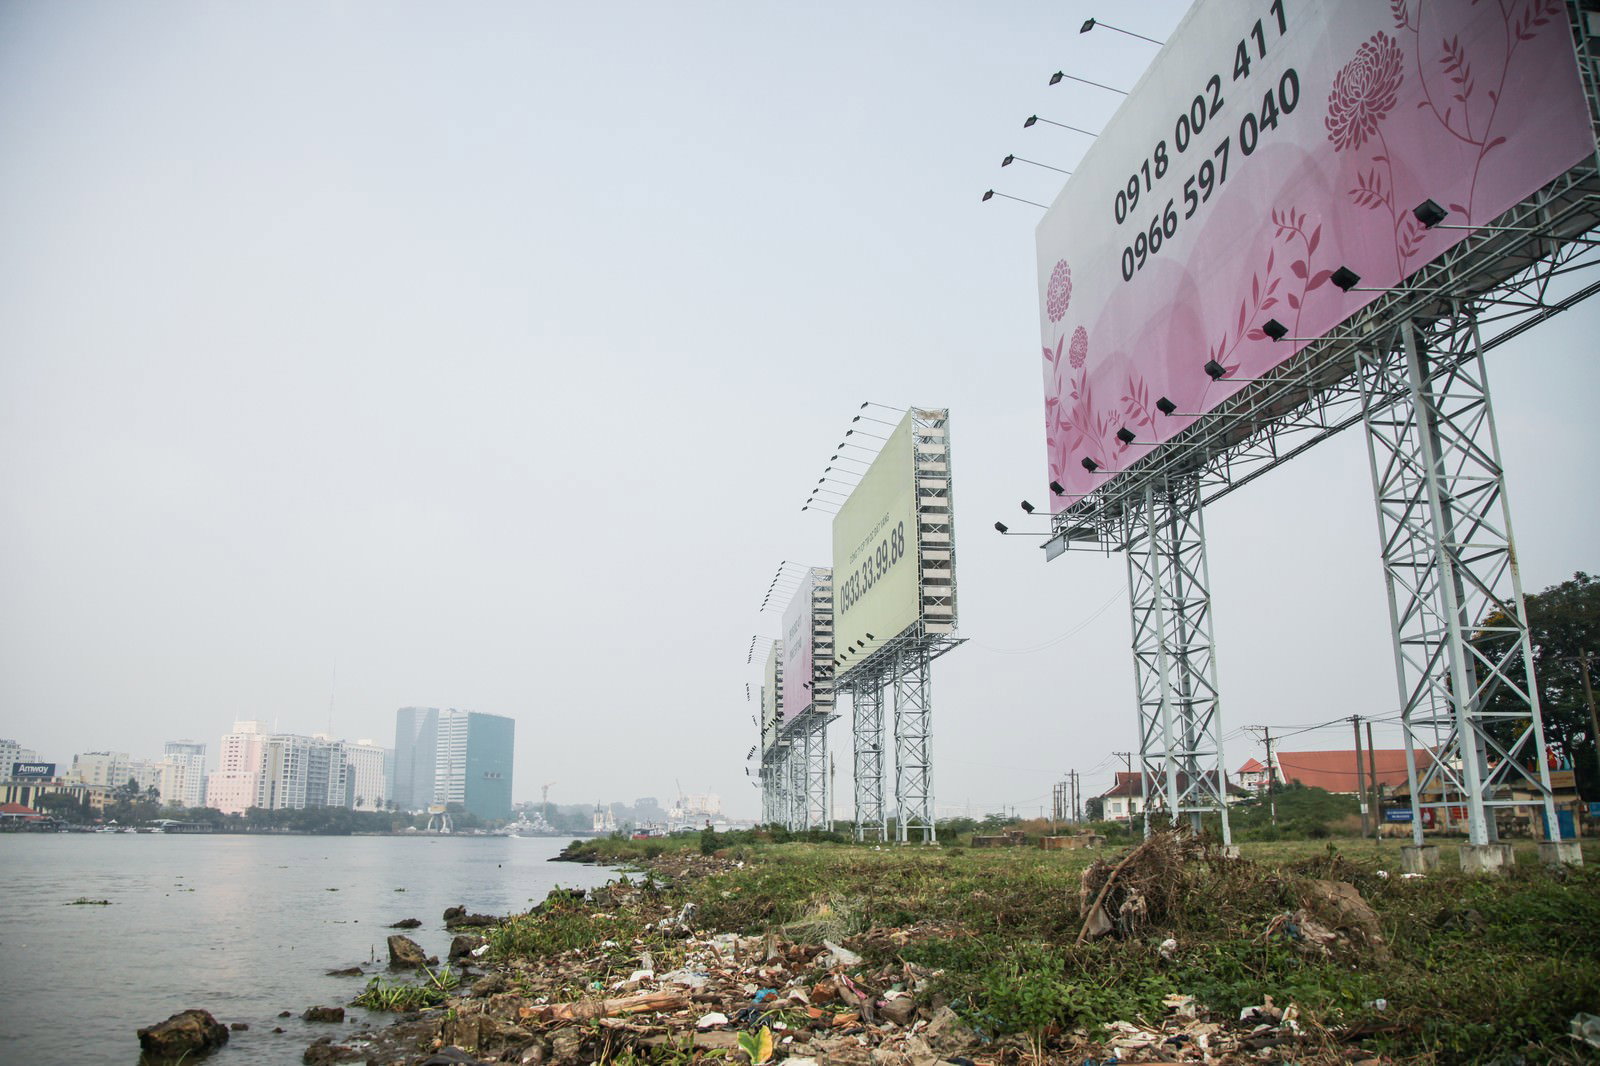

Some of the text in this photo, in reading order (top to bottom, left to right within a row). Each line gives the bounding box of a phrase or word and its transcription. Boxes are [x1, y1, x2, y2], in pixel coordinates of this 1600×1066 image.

[1114, 0, 1287, 225] 0918 002 411
[1121, 68, 1300, 282] 0966 597 040
[840, 520, 905, 615] 0933.33.99.88
[19, 764, 48, 774] Amway
